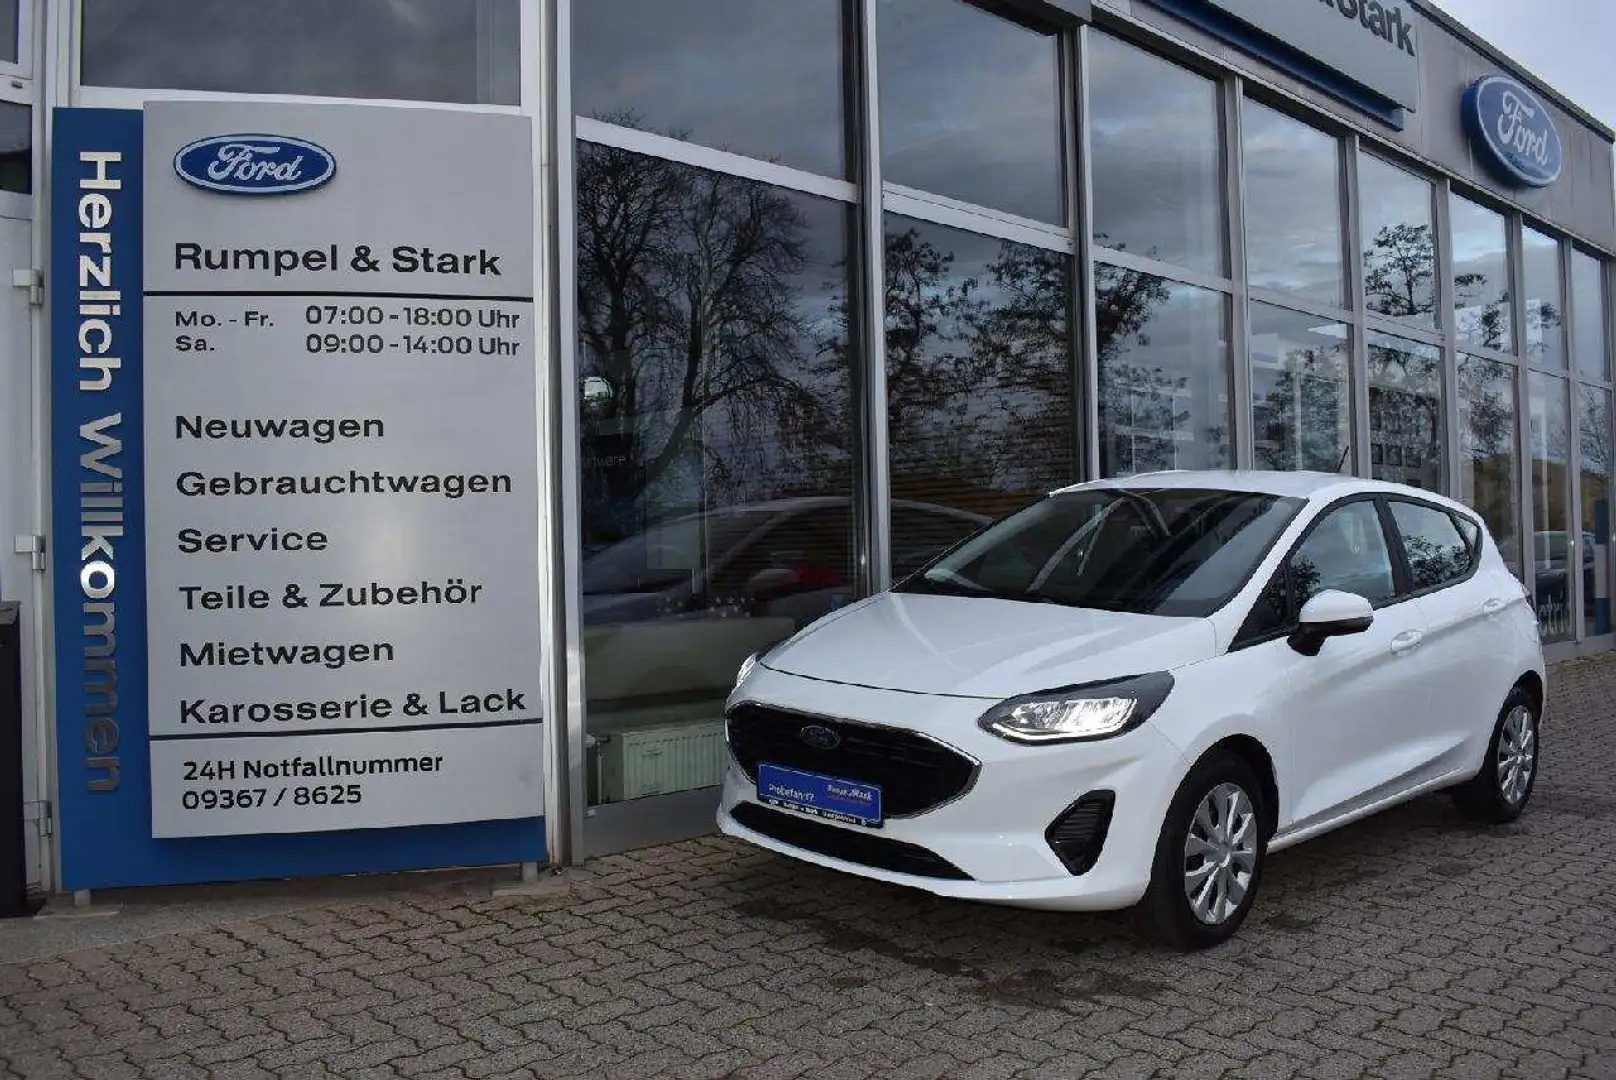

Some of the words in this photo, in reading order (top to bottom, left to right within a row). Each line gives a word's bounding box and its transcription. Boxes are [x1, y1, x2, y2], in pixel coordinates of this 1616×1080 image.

[1497, 91, 1548, 166] Ford
[207, 143, 303, 181] Ford
[79, 151, 122, 391] Herzlich
[175, 243, 337, 276] Rumpel
[351, 245, 380, 272] &
[392, 246, 501, 275] Stark
[176, 311, 221, 326] Mo.
[245, 311, 273, 326] Fr.
[479, 310, 519, 328] Uhr
[175, 335, 215, 352] Sa.
[479, 337, 520, 355] Uhr
[176, 416, 383, 444] Neuwagen
[176, 469, 511, 498] Gebrauchtwagen
[176, 527, 327, 553] Service
[80, 412, 125, 793] Willkommen
[179, 585, 270, 610] Teile
[282, 584, 308, 608] &
[320, 579, 482, 607] Zubehör
[180, 641, 393, 669] Mietwagen
[181, 693, 392, 725] Karosserie
[403, 693, 429, 716] &
[439, 689, 526, 715] Lack
[183, 760, 237, 781] 24H
[244, 756, 443, 779] Notfallnummer
[182, 788, 268, 809] 09367
[293, 785, 362, 805] 8625
